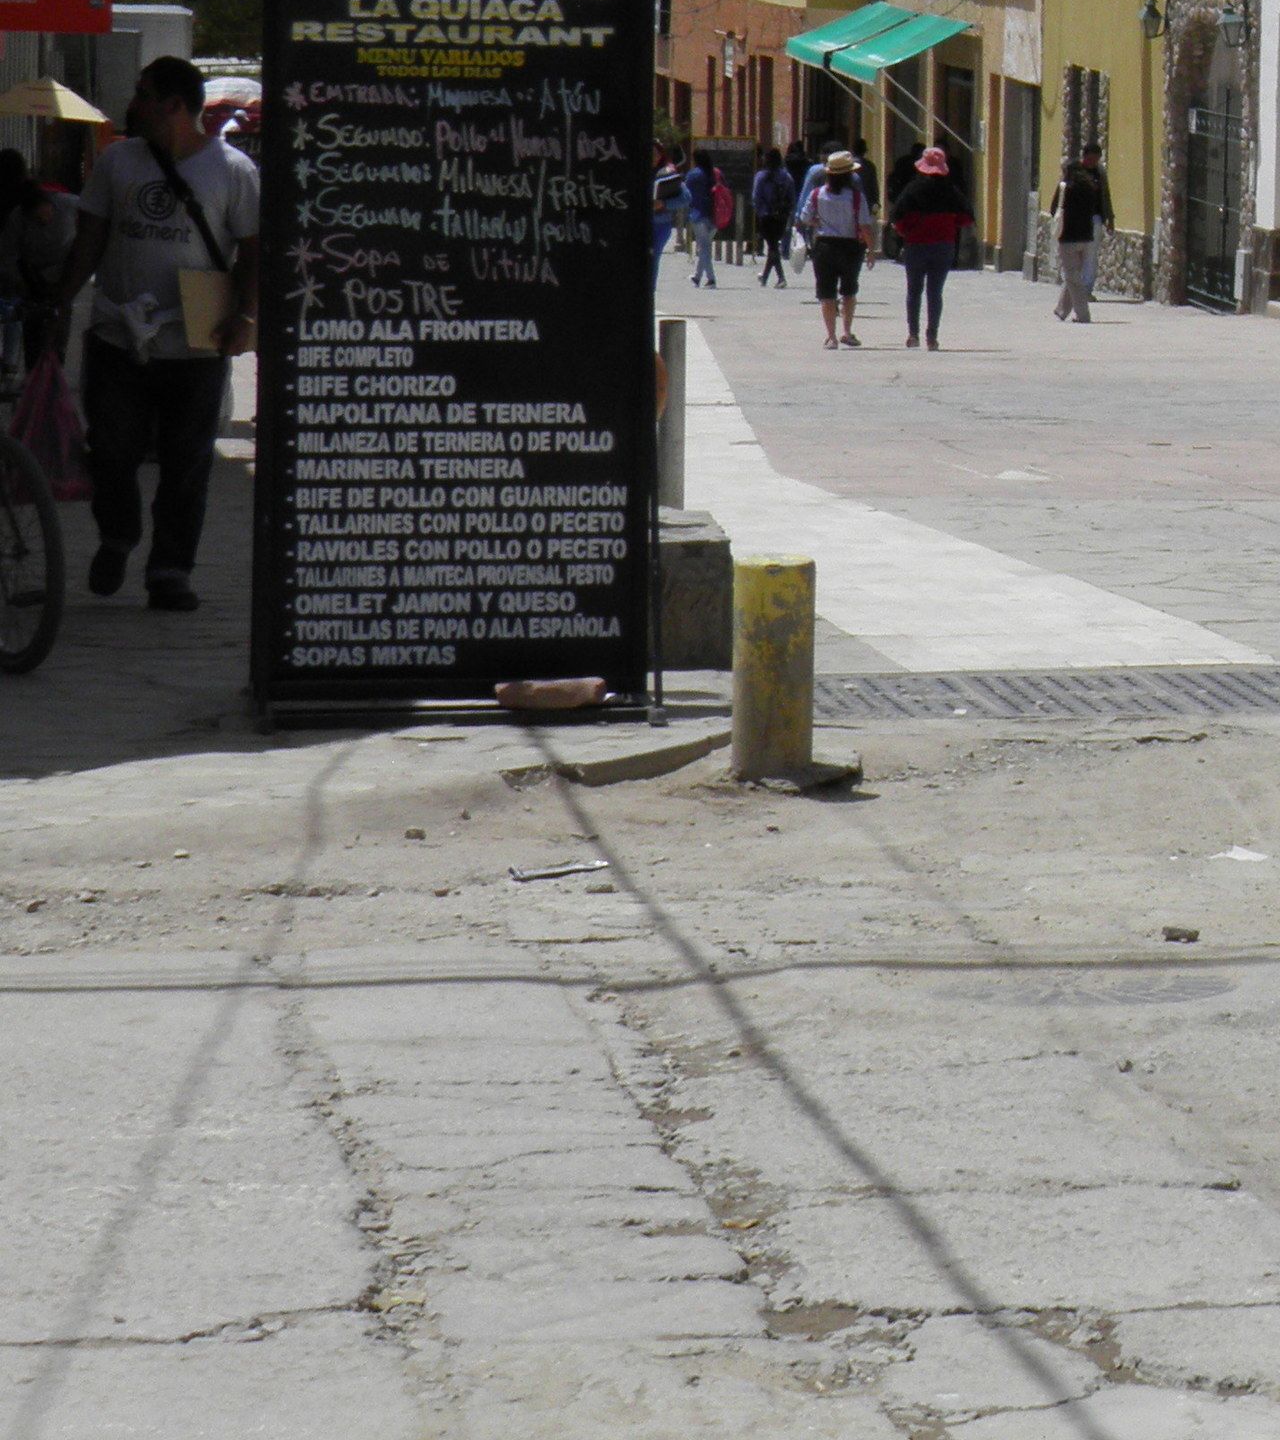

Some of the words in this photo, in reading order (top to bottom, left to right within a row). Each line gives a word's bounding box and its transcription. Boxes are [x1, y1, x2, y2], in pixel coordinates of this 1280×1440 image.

[291, 21, 615, 47] RESTAURANT
[356, 47, 416, 64] MENU
[420, 48, 525, 67] VARIADOS
[301, 317, 364, 341] LOMO
[369, 320, 414, 341] ALA
[420, 320, 539, 341] FRONTERA
[298, 347, 331, 368] BIFE
[334, 347, 414, 368] COMPLETO
[298, 376, 348, 396] BIFE
[355, 376, 456, 396] CHORIZO
[298, 403, 442, 424] NAPOLITANA
[449, 403, 477, 424] DE
[483, 403, 587, 424] TERNERA
[298, 431, 390, 452] MILANEZA
[395, 431, 418, 452] DE
[424, 431, 505, 452] TERNERA
[510, 431, 523, 452] O
[528, 431, 551, 452] DE
[556, 431, 614, 452] POLLO
[297, 459, 415, 479] MARINERA
[421, 459, 525, 479] TERNERA
[297, 486, 342, 508] BIFE
[348, 486, 375, 508] DE
[380, 486, 445, 508] POLLO
[452, 486, 496, 508] CON
[501, 479, 628, 506] GUARNICIÓN
[297, 513, 414, 534] TALLARINES
[419, 513, 460, 534] CON
[465, 513, 527, 534] POLLO
[532, 513, 546, 534] O
[551, 513, 625, 534] PECETO
[298, 539, 400, 560] RAVIOLES
[405, 539, 449, 560] CON
[454, 539, 521, 560] POLLO
[527, 539, 542, 560] O
[547, 539, 627, 560] PECETO
[296, 565, 386, 586] TALLARINES
[389, 565, 400, 586] A
[403, 565, 475, 586] MANTECA
[567, 564, 614, 585] PESTO
[295, 592, 386, 614] OMELET
[392, 592, 471, 614] JAMON
[478, 592, 494, 614] Y
[500, 592, 576, 614] QUESO
[295, 618, 391, 640] TORTILLAS
[397, 618, 420, 640] DE
[424, 618, 468, 640] PAPA
[472, 618, 485, 640] O
[490, 618, 524, 640] ALA
[529, 613, 621, 637] ESPAÑOLA
[292, 646, 365, 667] SOPAS
[372, 646, 456, 667] MIXTAS
